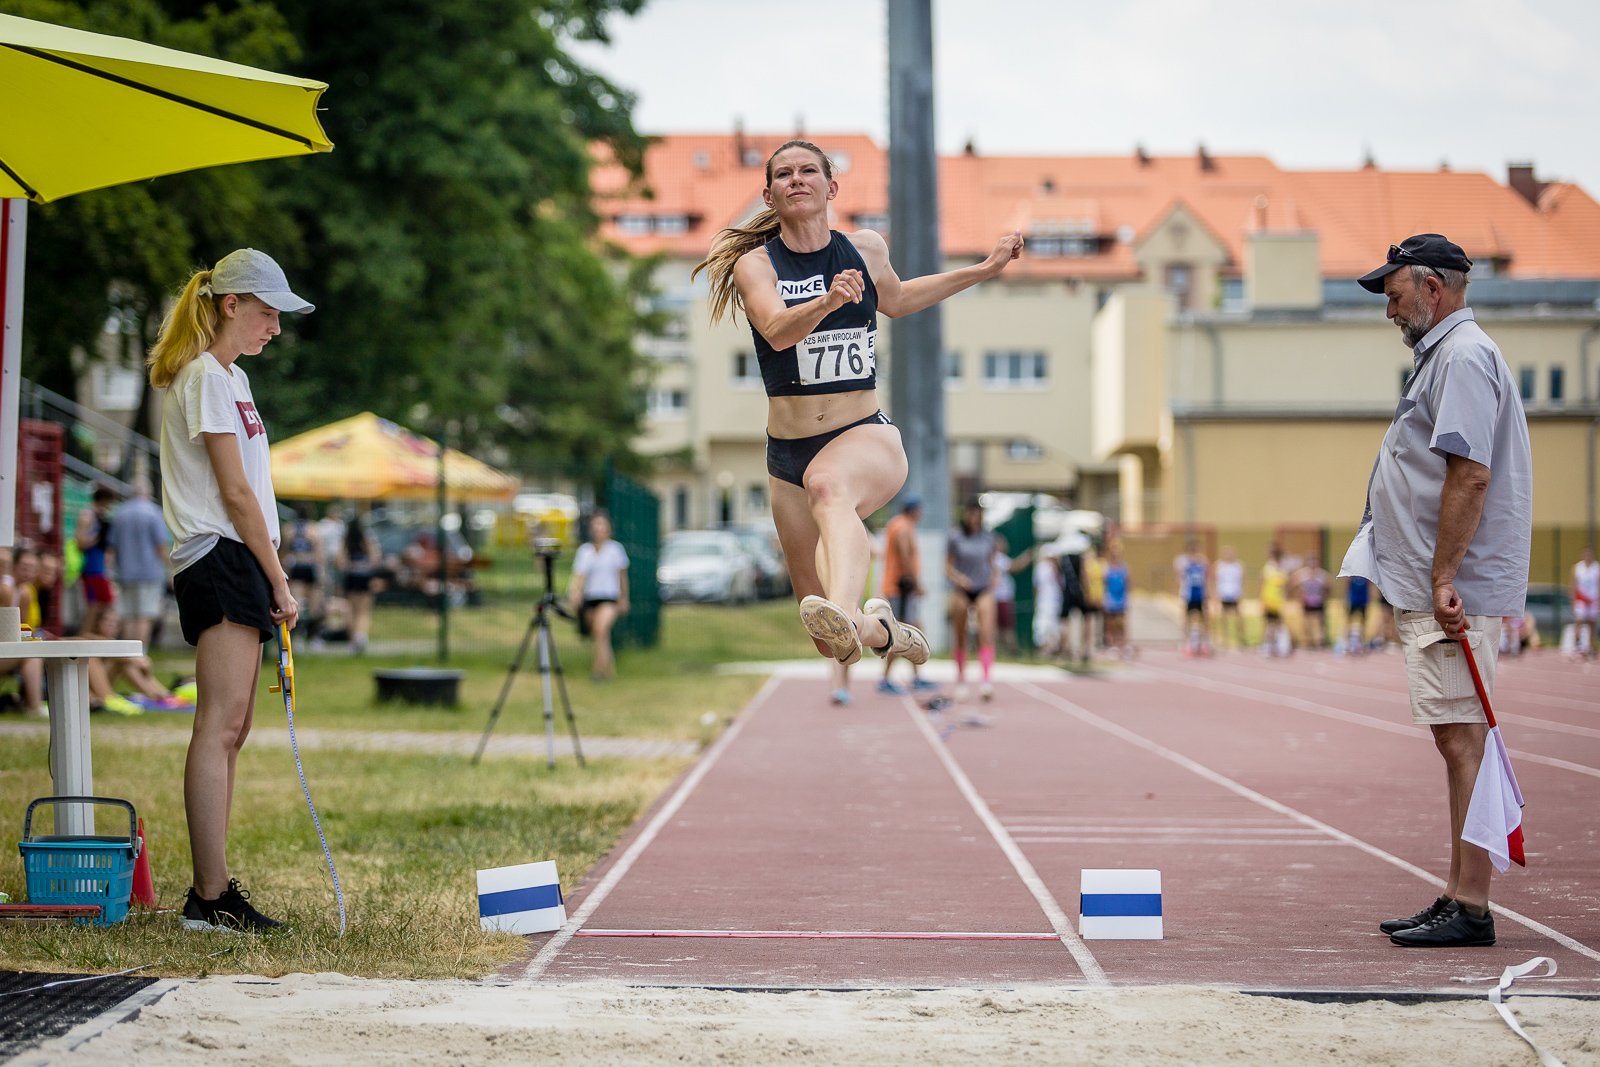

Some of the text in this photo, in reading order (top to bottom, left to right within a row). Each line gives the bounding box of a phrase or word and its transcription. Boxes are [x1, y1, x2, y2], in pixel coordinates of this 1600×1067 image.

[781, 279, 822, 295] NIKE
[804, 336, 816, 345] AZS
[817, 334, 830, 343] AWF
[808, 343, 863, 379] 776
